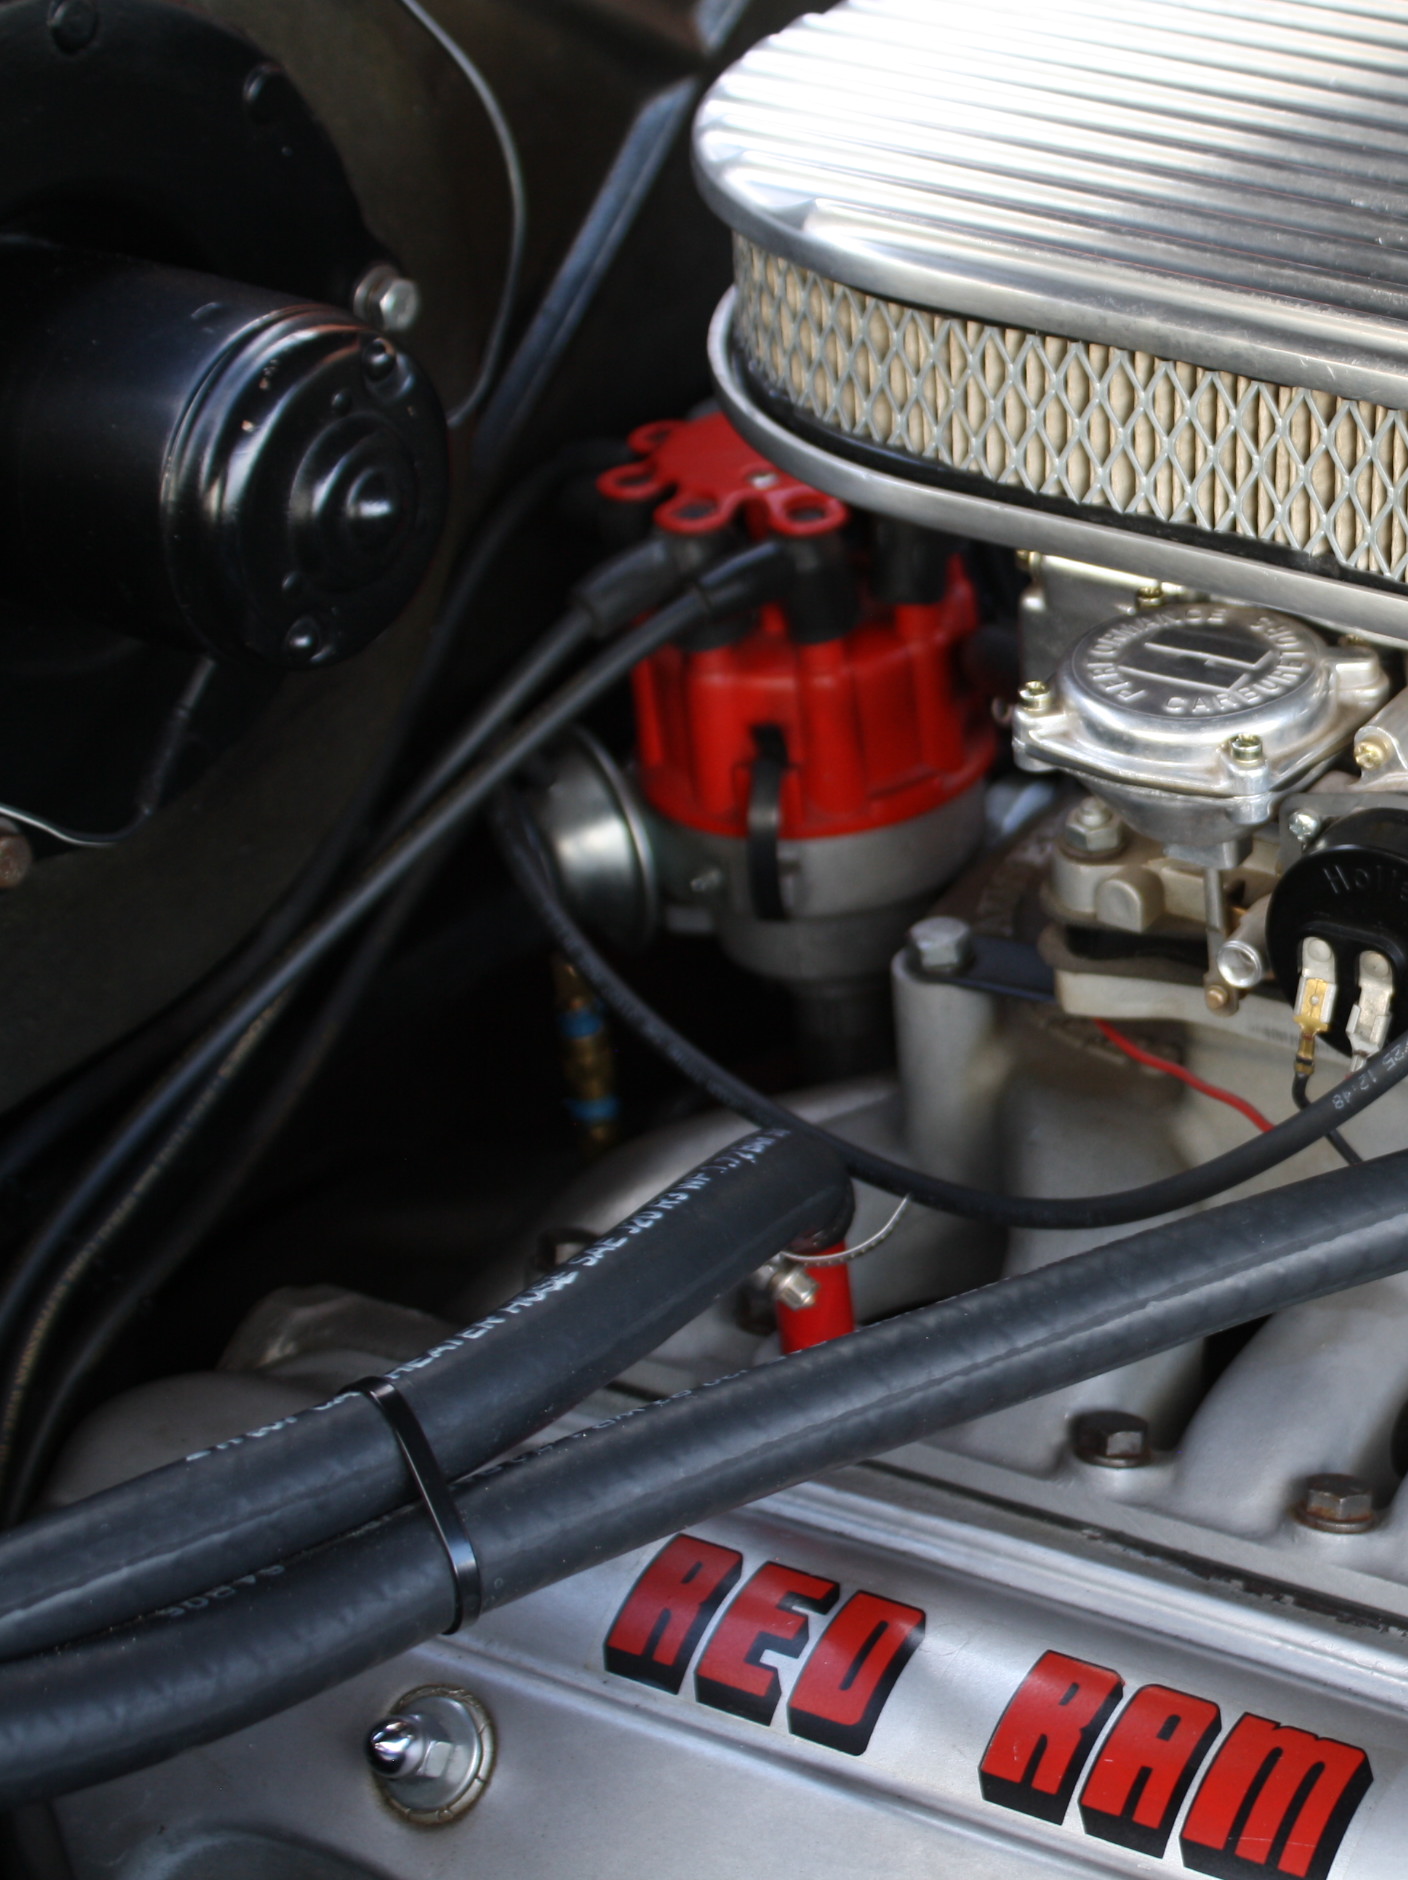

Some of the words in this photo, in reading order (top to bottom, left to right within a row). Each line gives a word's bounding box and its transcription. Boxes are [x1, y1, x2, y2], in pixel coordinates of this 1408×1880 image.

[1087, 608, 1228, 702] PERFORMANCE
[568, 1236, 629, 1268] SAE
[604, 1533, 927, 1757] RED
[978, 1649, 1375, 1880] RAM
